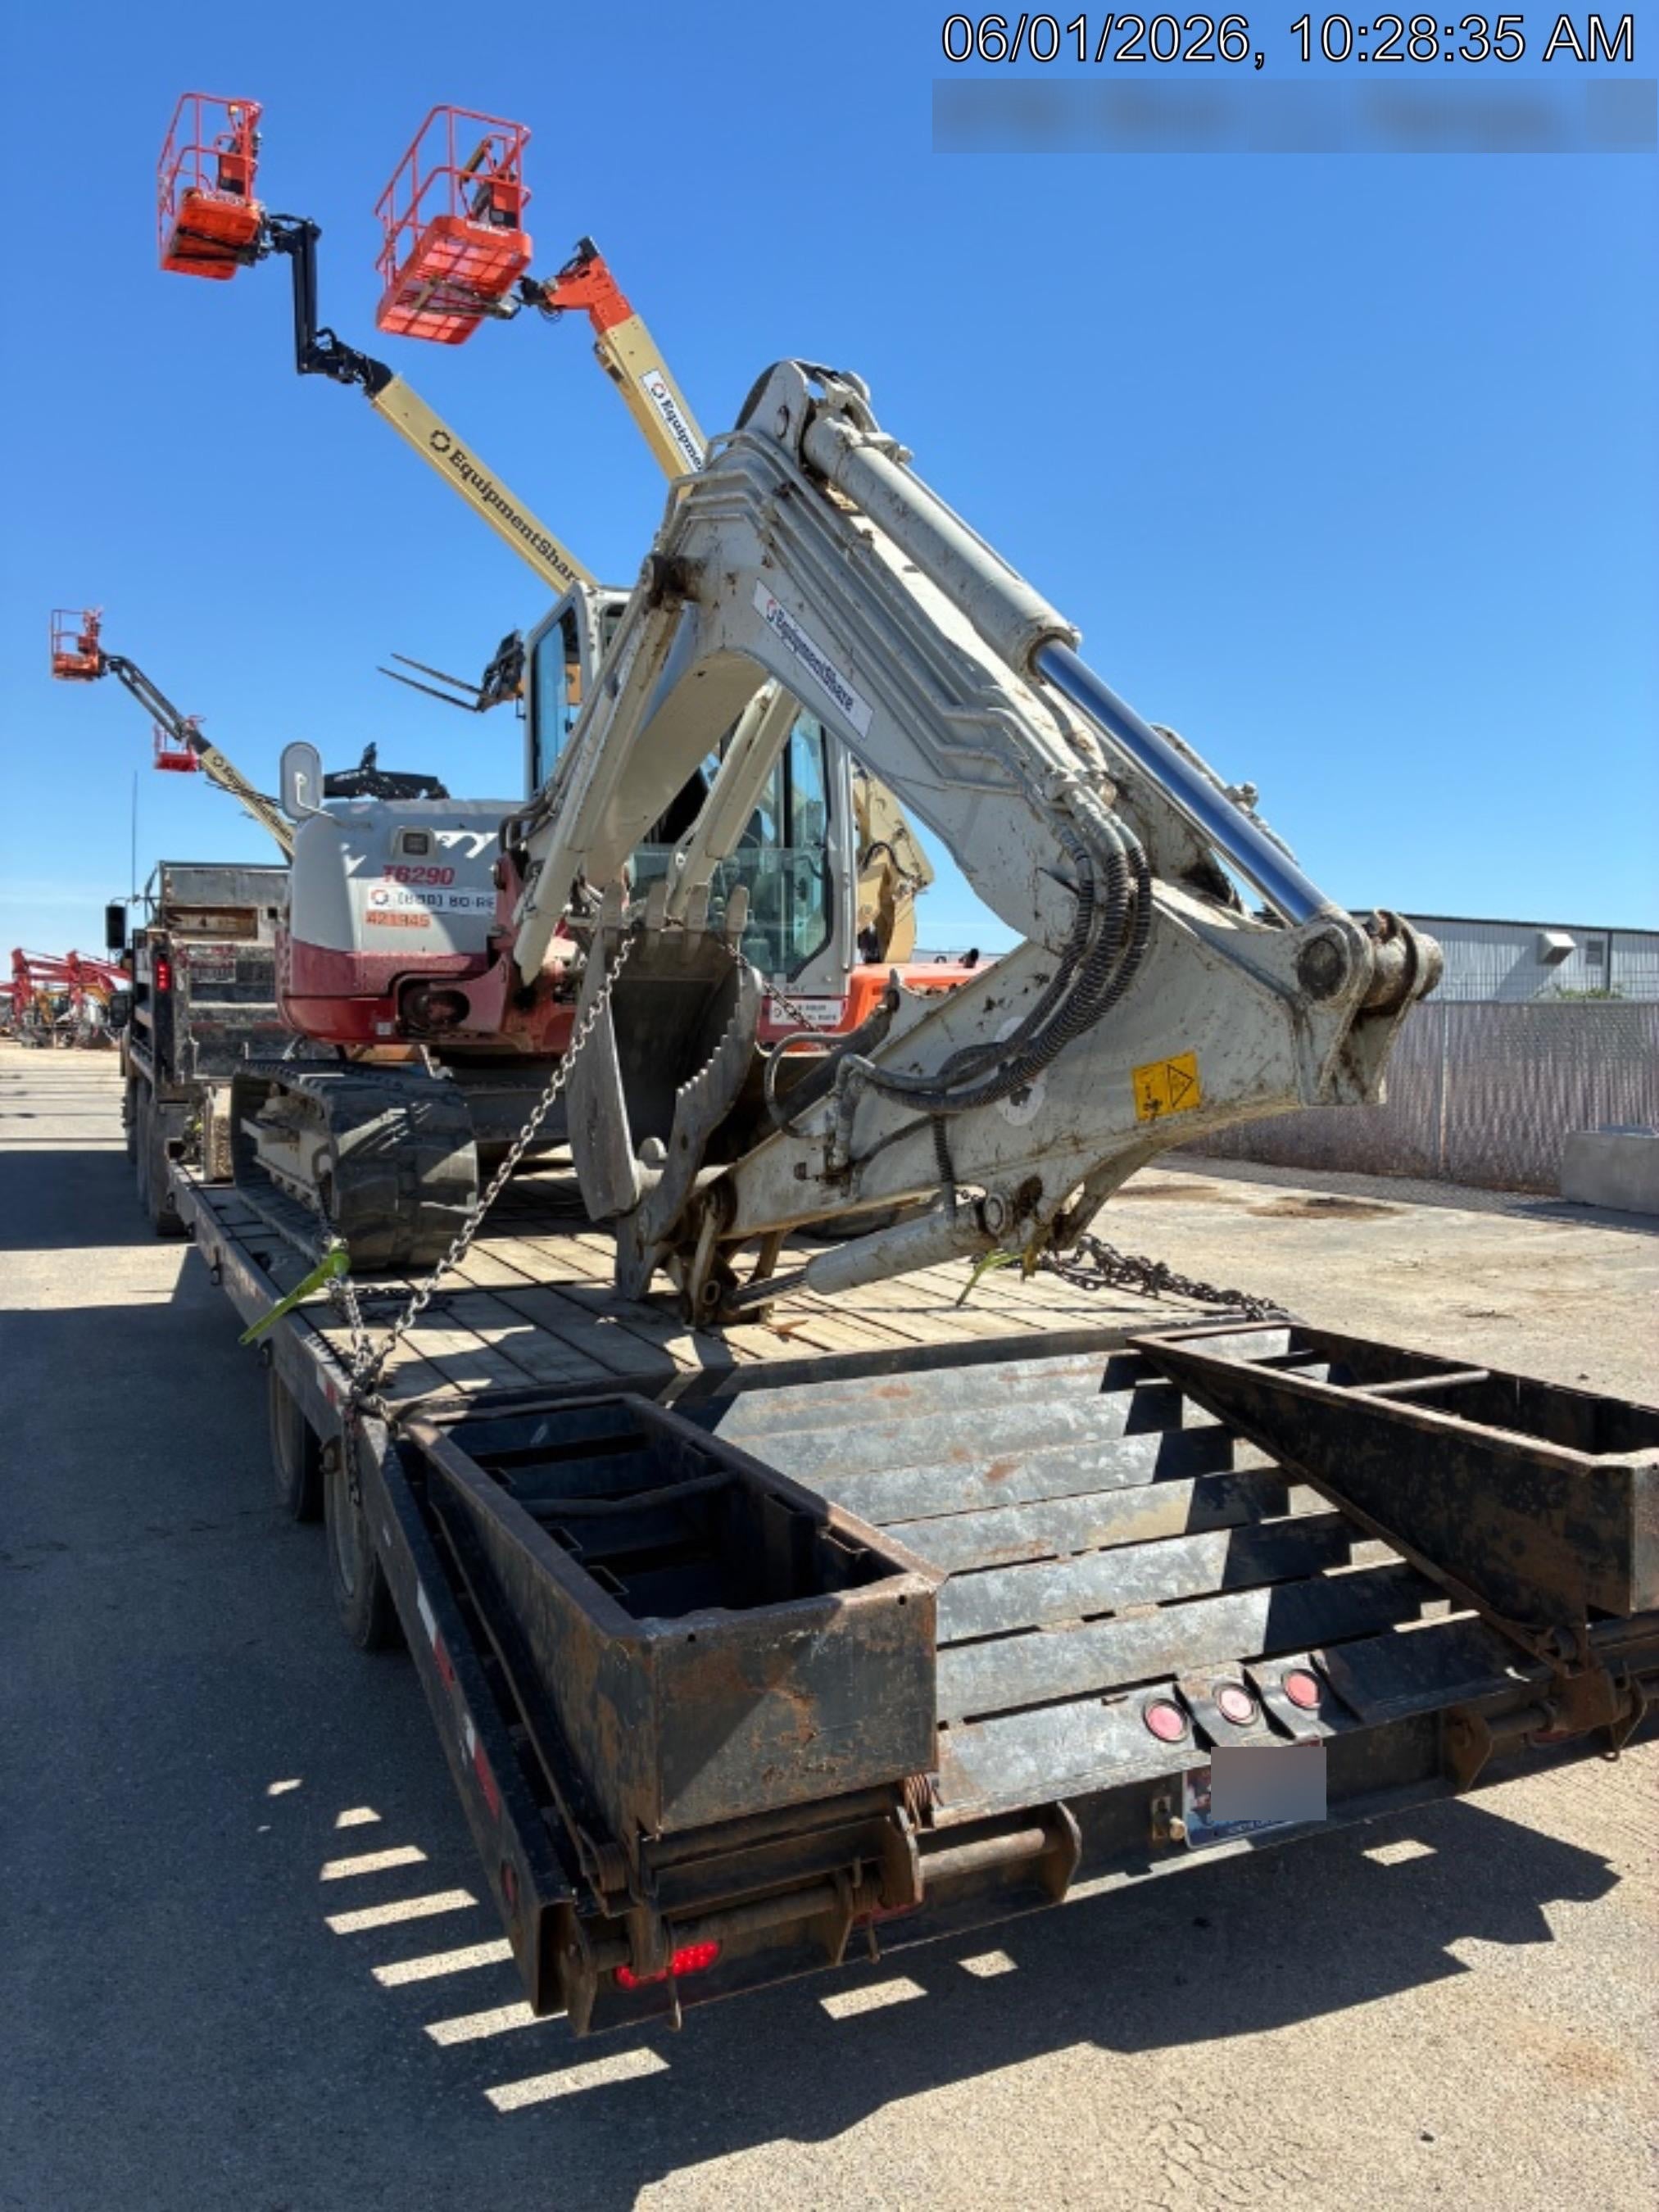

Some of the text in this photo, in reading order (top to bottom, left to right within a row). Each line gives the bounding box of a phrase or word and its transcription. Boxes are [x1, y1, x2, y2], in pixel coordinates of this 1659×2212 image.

[660, 399, 703, 471] Equipme
[448, 450, 581, 583] EquipmentShar
[776, 609, 854, 712] EquipmentShare
